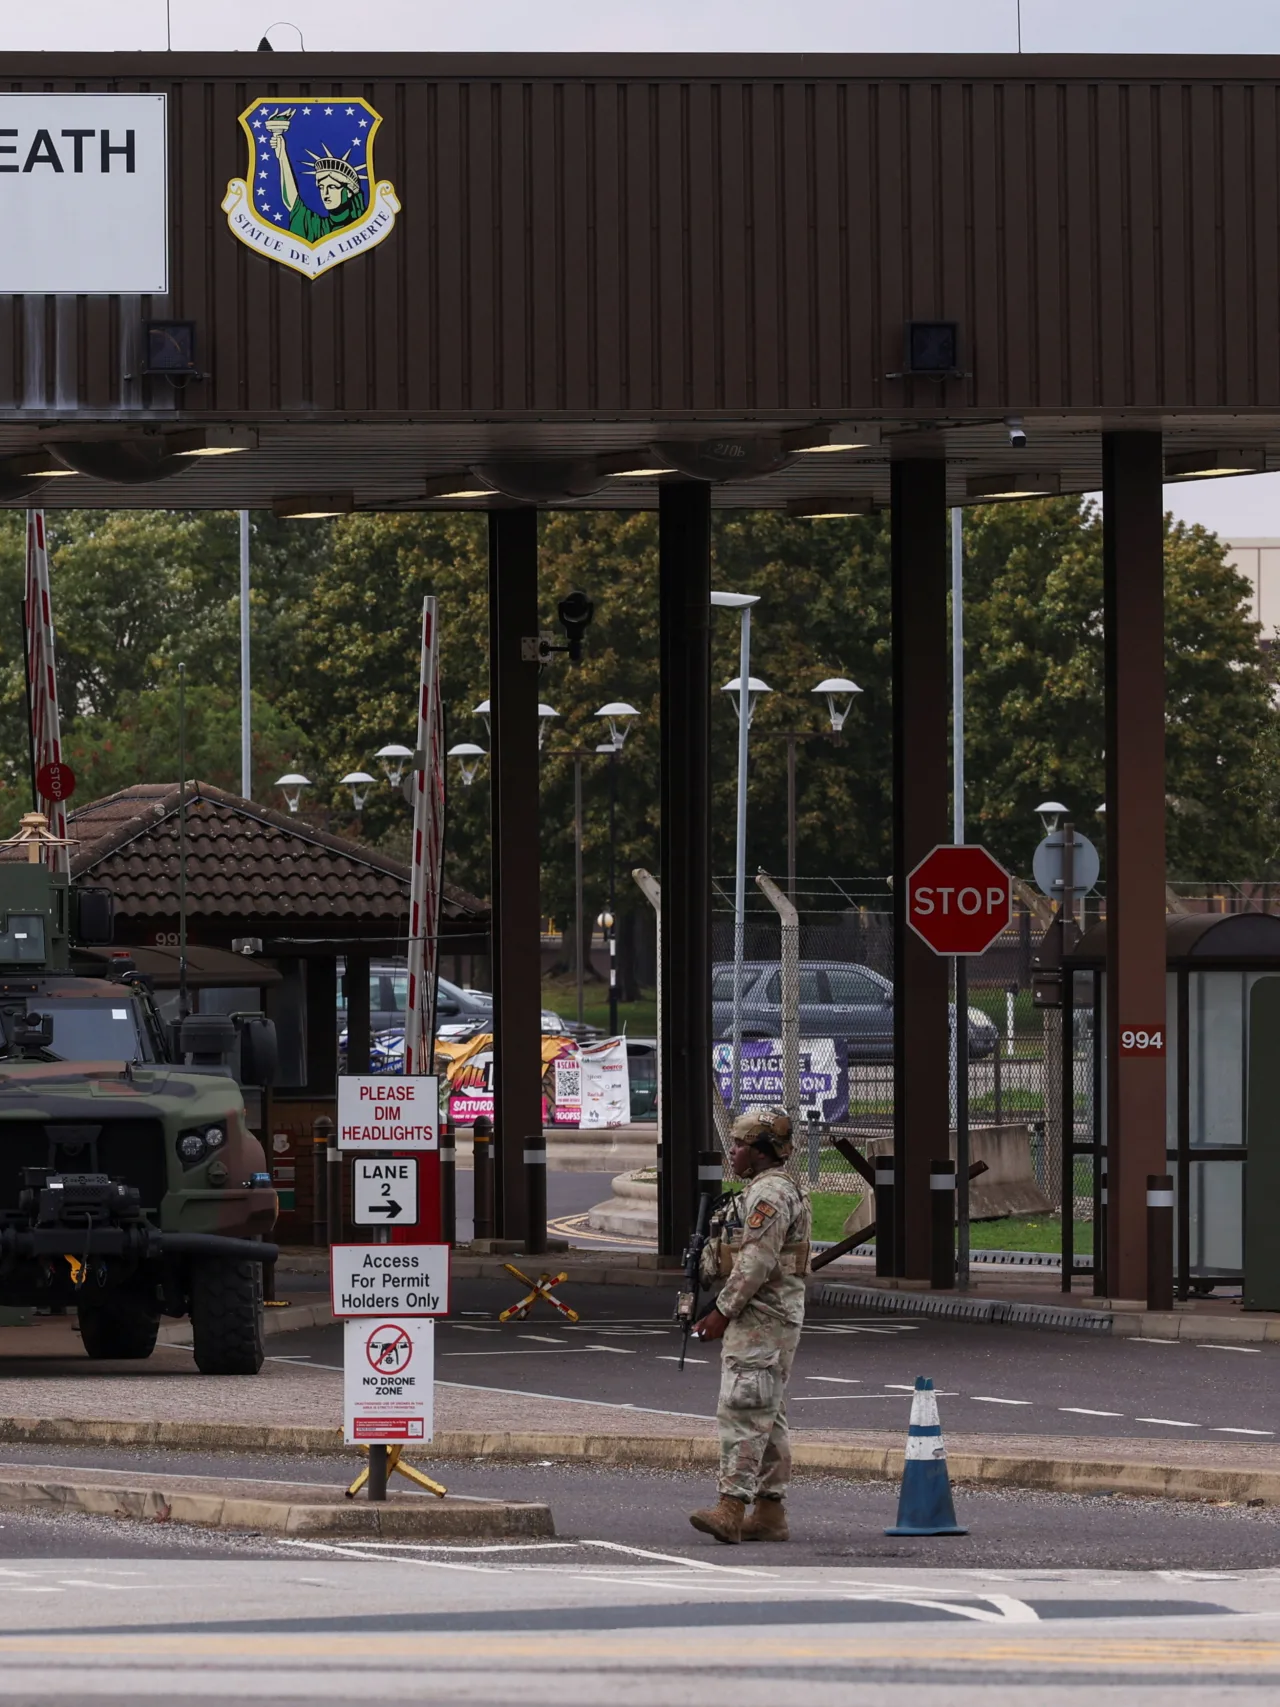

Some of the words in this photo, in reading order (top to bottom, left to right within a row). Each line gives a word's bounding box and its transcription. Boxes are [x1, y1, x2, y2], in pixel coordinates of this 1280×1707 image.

[234, 213, 284, 252] STATUE
[289, 249, 310, 265] DE
[316, 250, 336, 267] LA
[338, 210, 390, 253] LIBERTE
[50, 767, 62, 798] STOP
[913, 886, 1006, 915] STOP
[1121, 1031, 1163, 1048] 994
[740, 1058, 806, 1072] SUICIE
[721, 1076, 826, 1091] PEVENON
[359, 1086, 415, 1101] PLEASE
[374, 1106, 401, 1121] DIM
[453, 1100, 494, 1112] SATURD
[342, 1126, 433, 1141] HEADLIGHTS
[362, 1165, 408, 1179] LANE
[380, 1182, 391, 1197] 2
[362, 1253, 419, 1268] Access
[351, 1273, 375, 1288] For
[382, 1273, 430, 1288] Permit
[341, 1293, 399, 1308] Holders
[406, 1292, 440, 1310] Only
[362, 1377, 378, 1386] NO
[380, 1377, 416, 1386] DRONE
[375, 1387, 403, 1395] ZONE
